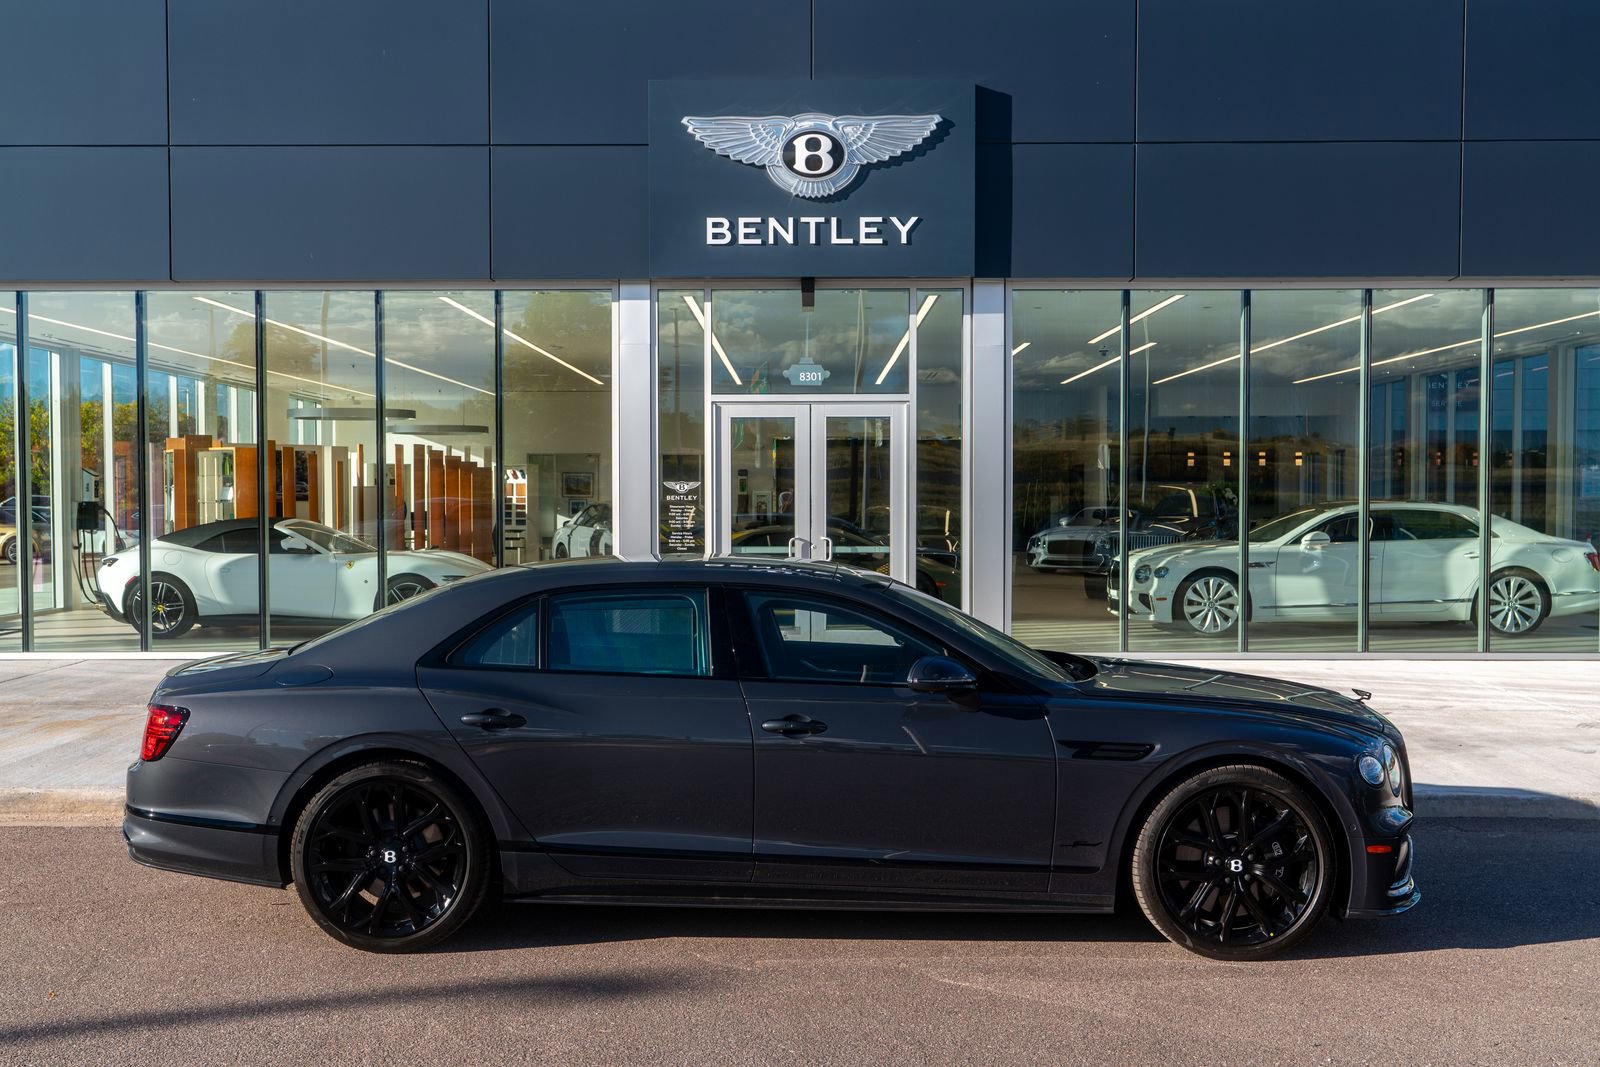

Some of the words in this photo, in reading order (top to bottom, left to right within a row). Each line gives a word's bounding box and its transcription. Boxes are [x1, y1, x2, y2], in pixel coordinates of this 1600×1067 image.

[793, 134, 834, 174] B
[706, 216, 919, 245] BENTLEY
[799, 372, 822, 381] 8301
[384, 851, 396, 863] B
[1230, 859, 1243, 872] B
